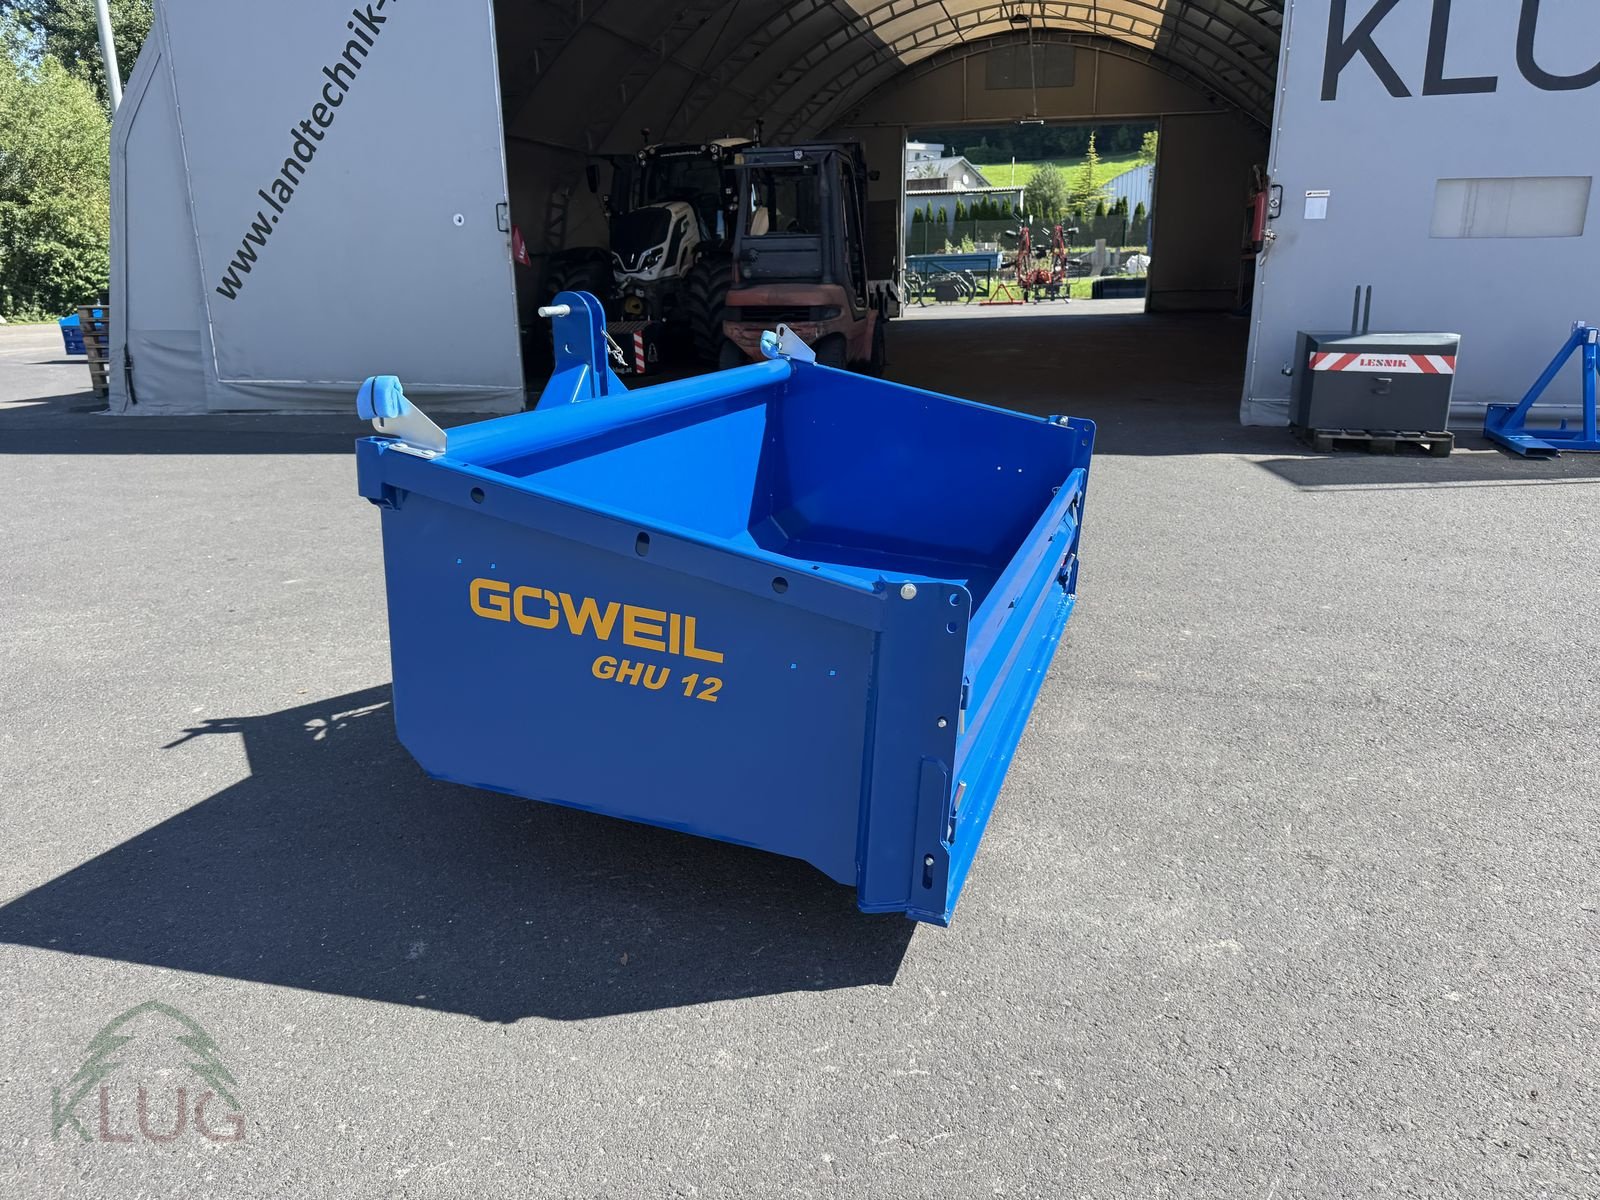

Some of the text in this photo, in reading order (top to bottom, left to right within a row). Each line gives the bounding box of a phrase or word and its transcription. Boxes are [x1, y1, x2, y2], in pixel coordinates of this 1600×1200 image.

[216, 0, 397, 299] www.landtechnik-
[1359, 358, 1408, 368] LESNIK
[591, 655, 723, 702] GHU 12
